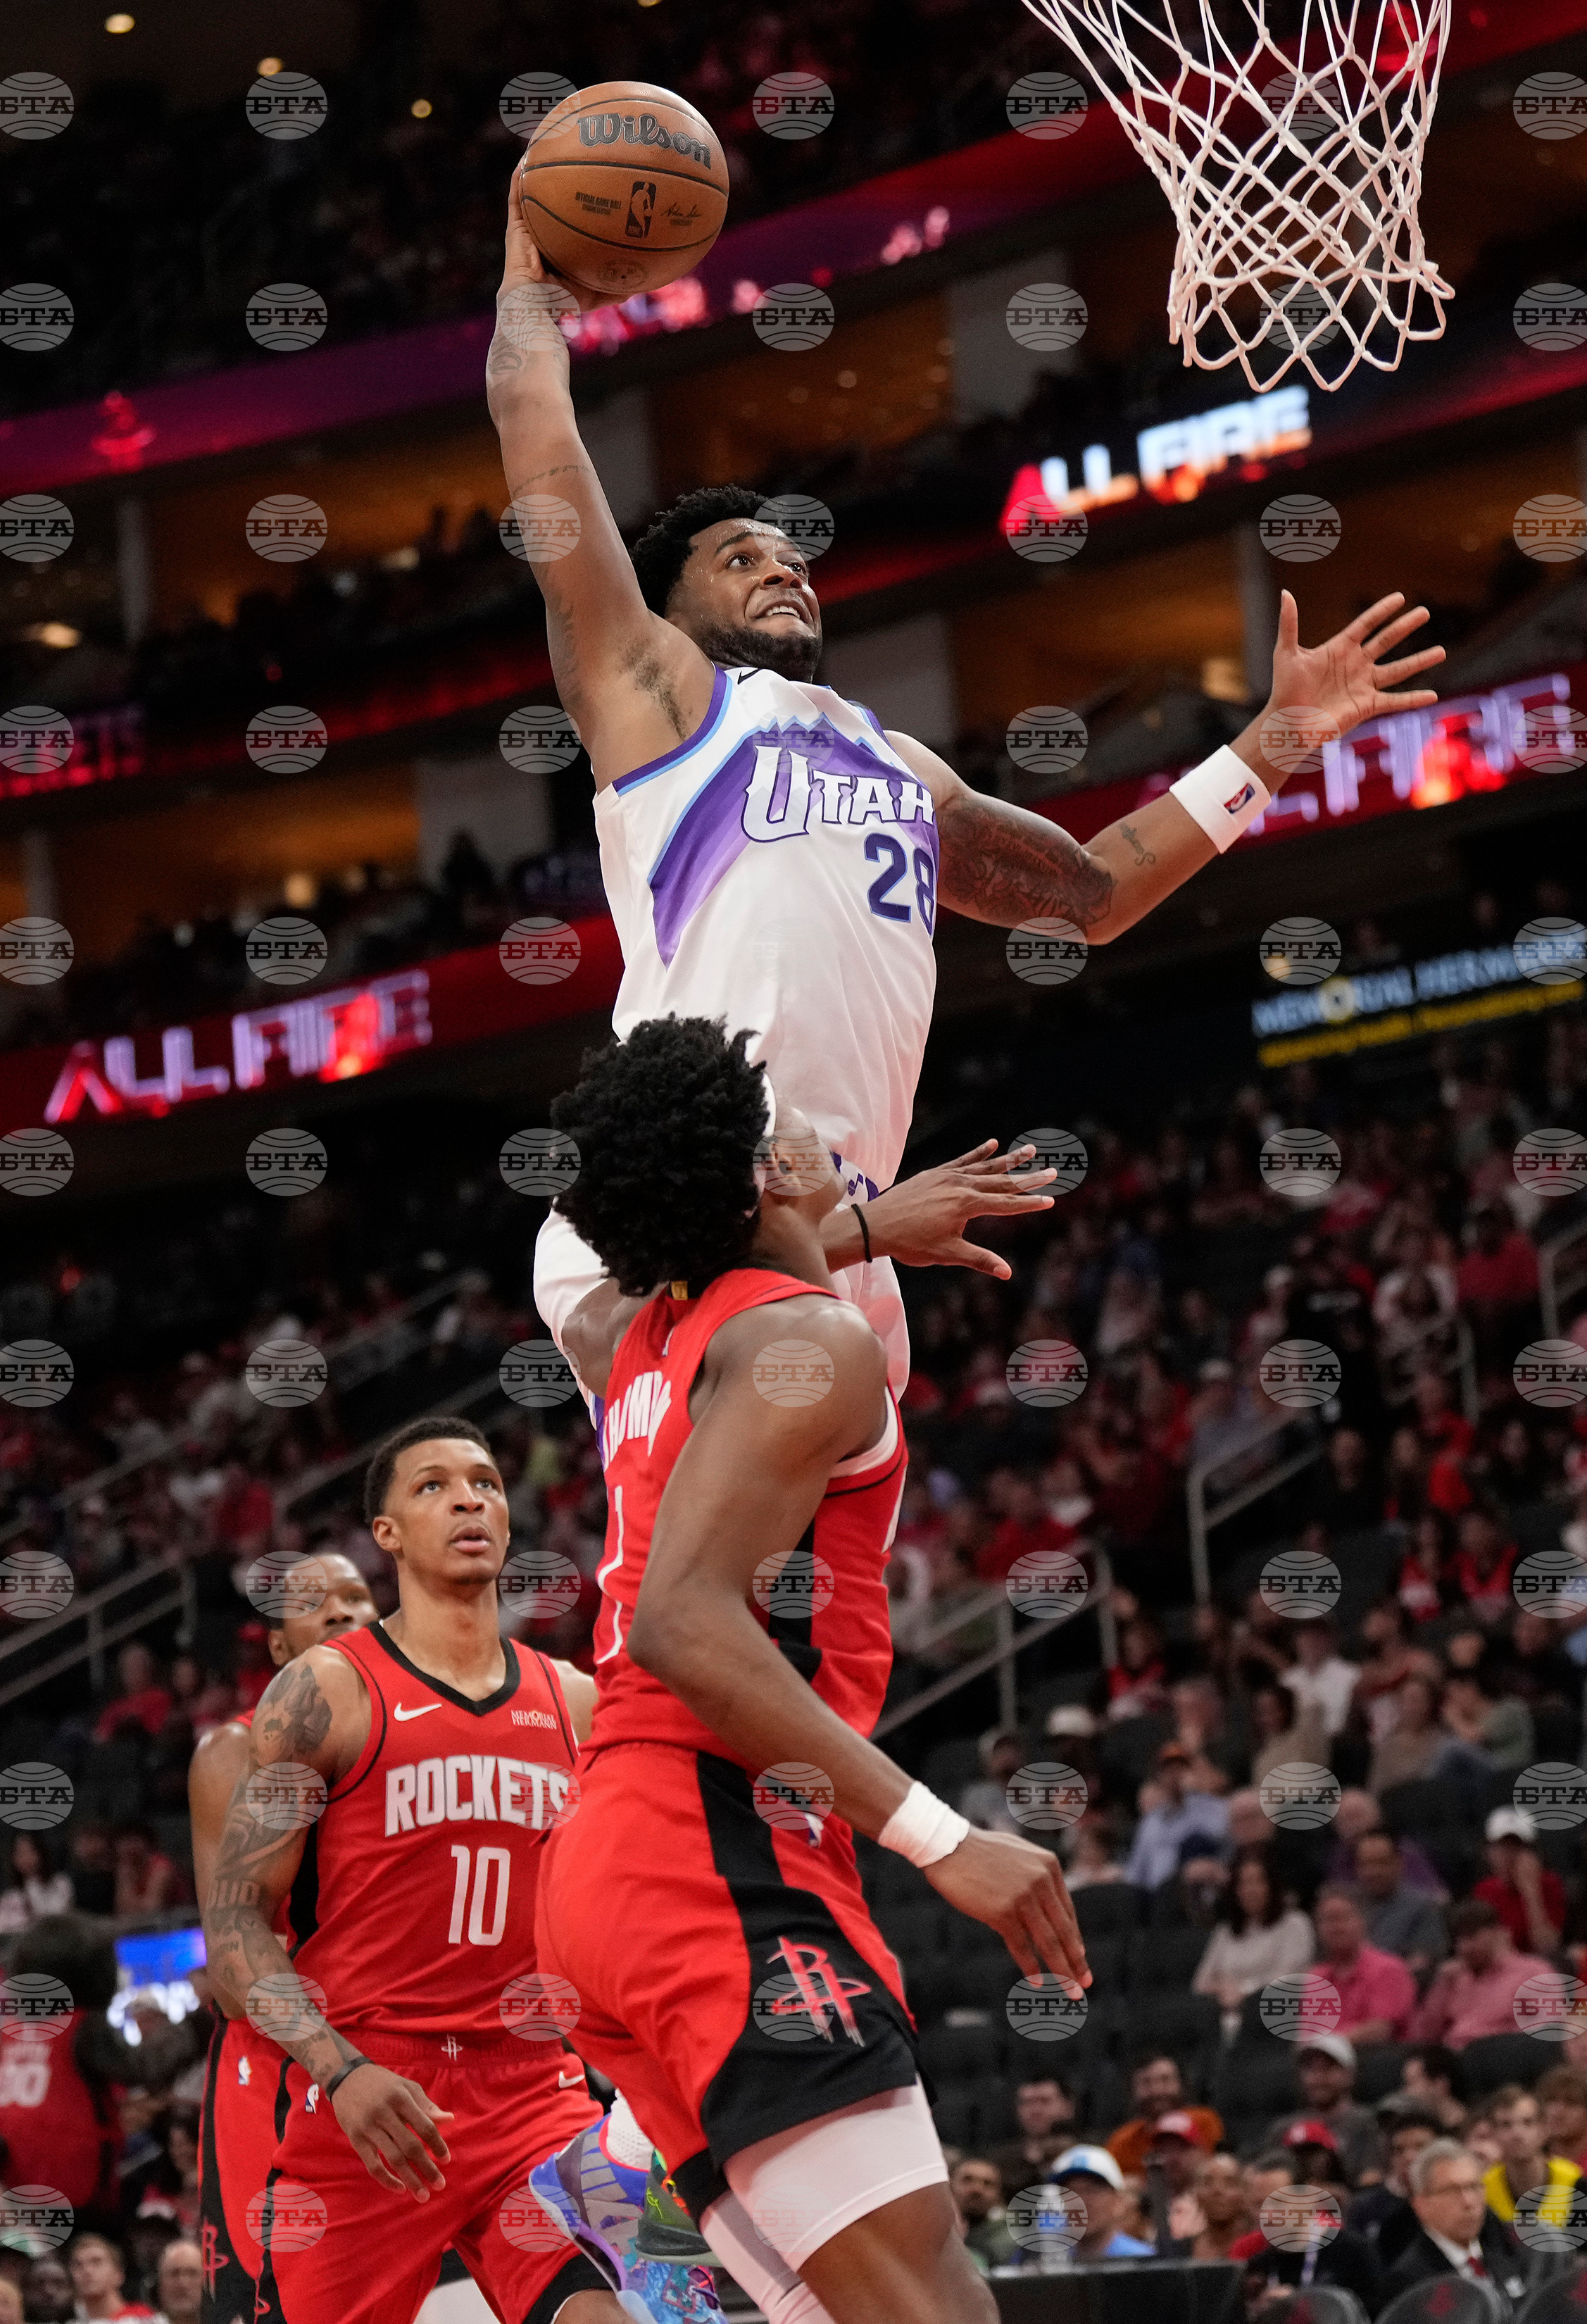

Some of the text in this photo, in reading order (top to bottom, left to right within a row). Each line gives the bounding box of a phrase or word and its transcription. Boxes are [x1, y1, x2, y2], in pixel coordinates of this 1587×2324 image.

[576, 113, 711, 170] Wilson
[741, 744, 936, 843] UTAH
[863, 832, 936, 938] 28
[384, 1754, 570, 1838] ROCKETS
[448, 1844, 511, 1947] 10
